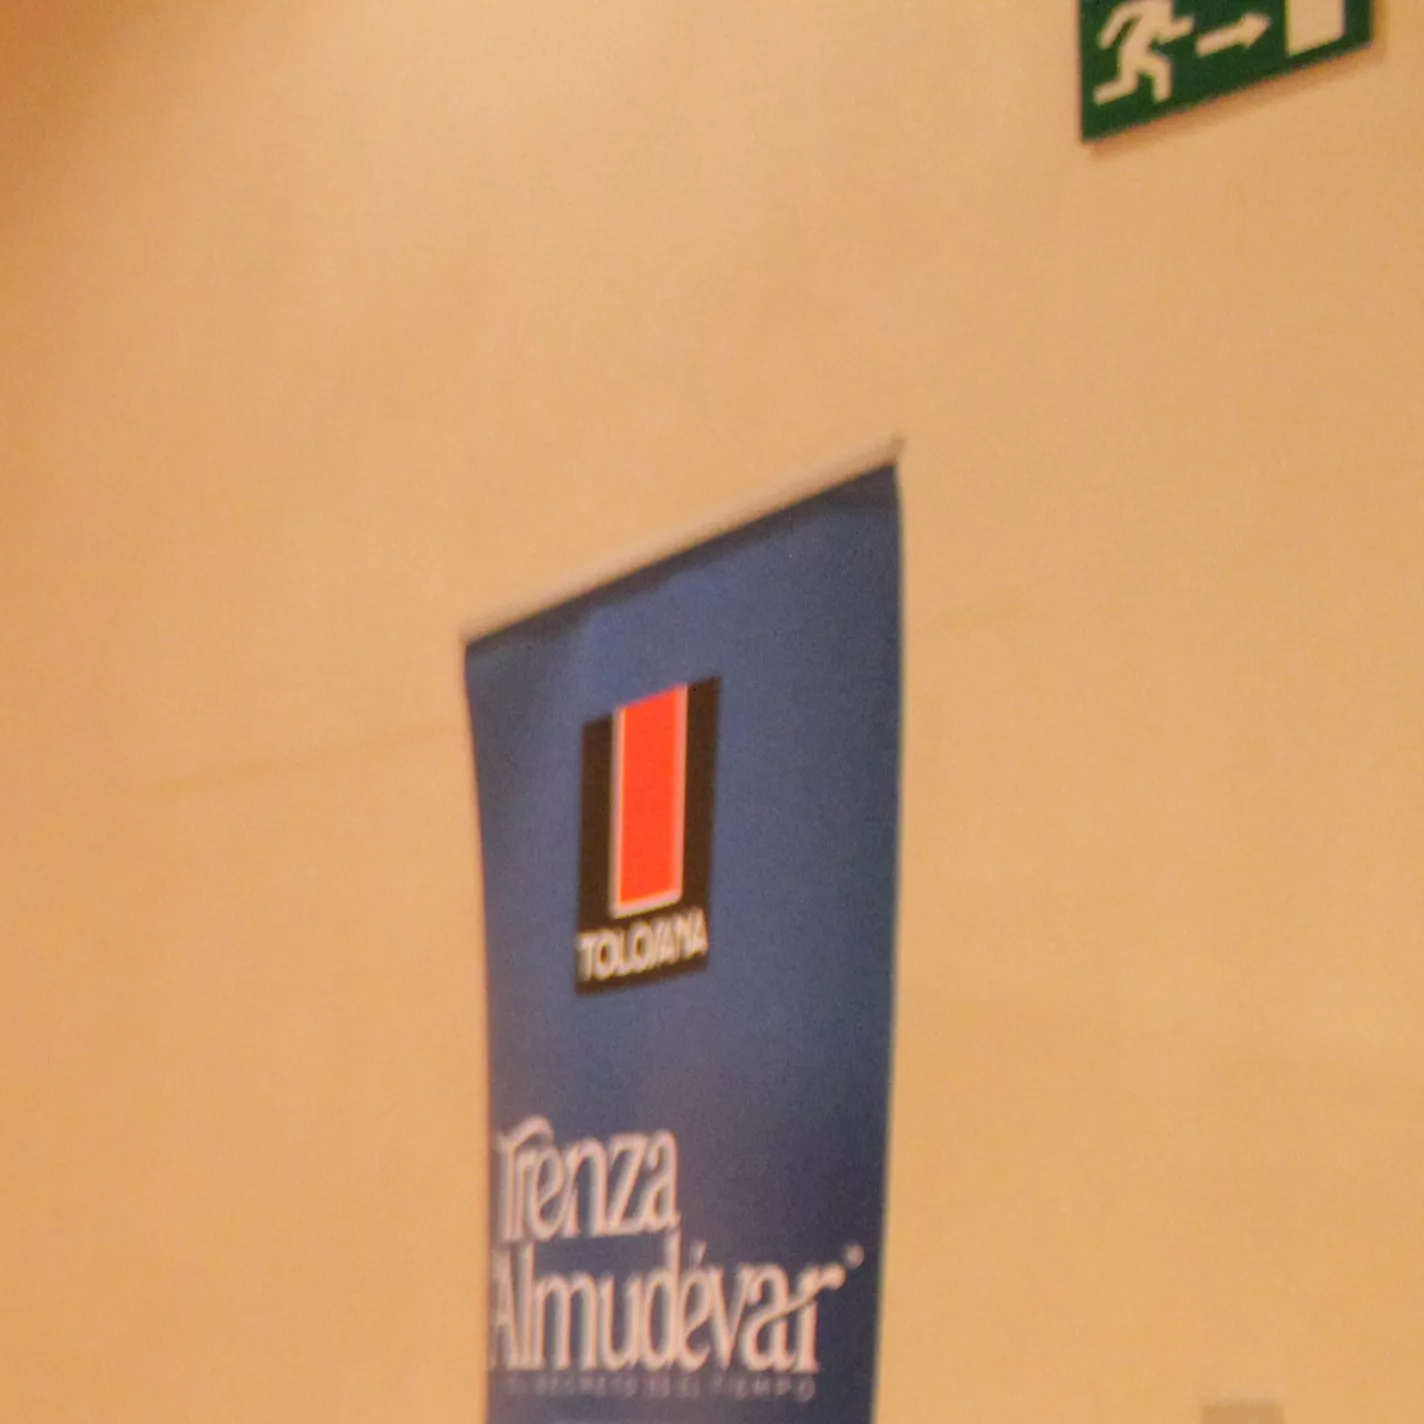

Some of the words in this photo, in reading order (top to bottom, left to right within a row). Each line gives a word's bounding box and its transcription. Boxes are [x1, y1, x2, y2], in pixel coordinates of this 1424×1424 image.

[576, 905, 709, 982] TOLOSANA
[493, 1113, 681, 1244] Trenza
[488, 1228, 846, 1374] Almudévar
